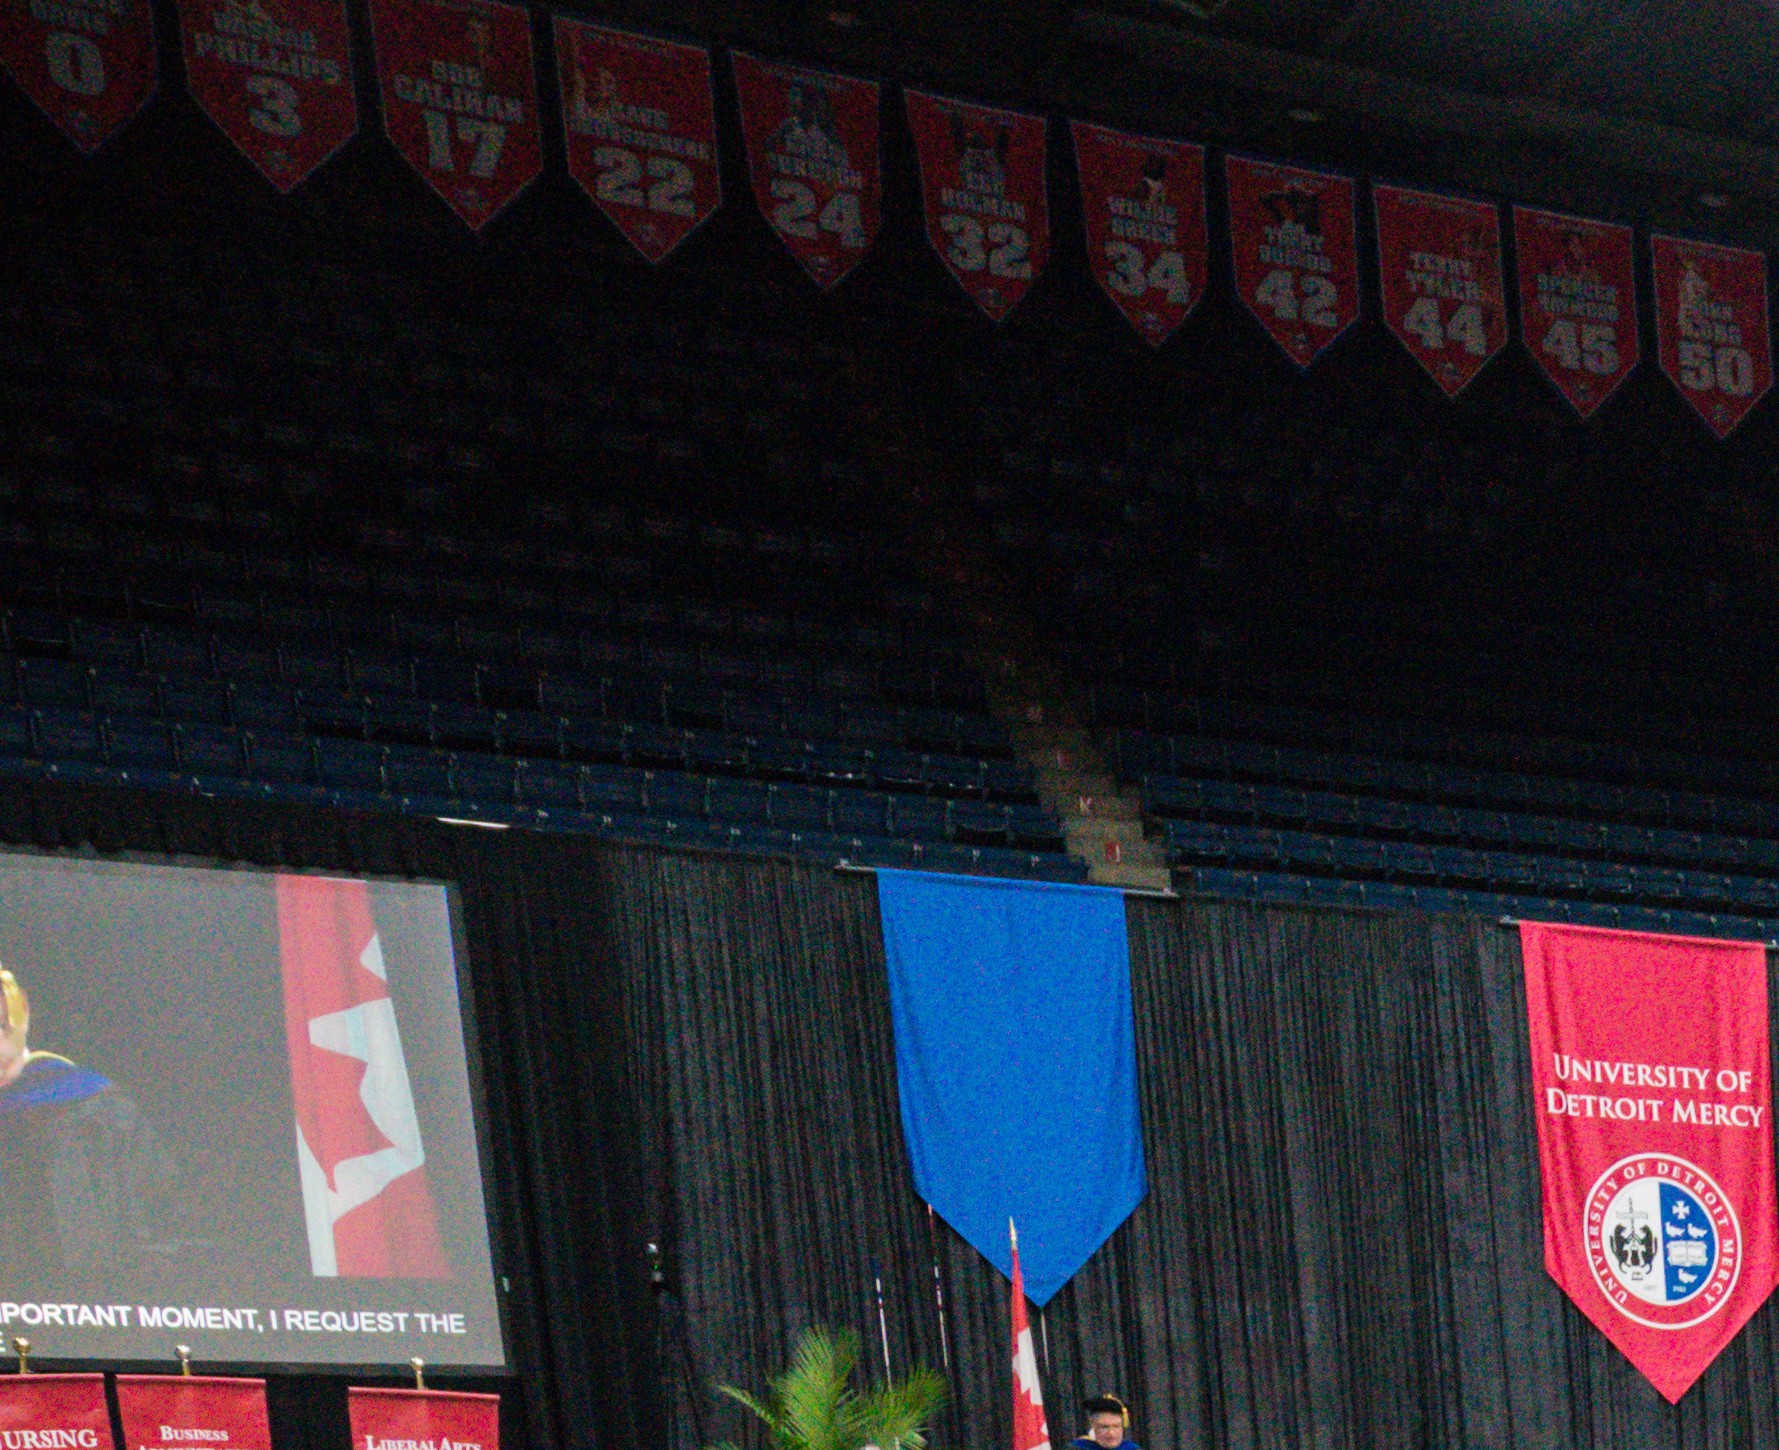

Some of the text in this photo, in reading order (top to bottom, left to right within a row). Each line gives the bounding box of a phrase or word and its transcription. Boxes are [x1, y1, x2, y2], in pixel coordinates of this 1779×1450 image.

[45, 31, 107, 95] 0
[194, 32, 342, 84] PHILLIPS
[245, 75, 302, 137] 3
[422, 108, 506, 178] 17
[593, 147, 696, 218] 22
[771, 178, 867, 248] 24
[939, 213, 1032, 280] 32
[1104, 240, 1190, 304] 34
[1255, 270, 1337, 328] 42
[1403, 297, 1487, 355] 44
[1542, 298, 1619, 375] 45
[1677, 340, 1753, 397] 50
[1553, 1052, 1752, 1093] UNIVERSITY OF
[1546, 1087, 1764, 1129] DETROIT MERCY
[1588, 1162, 1735, 1307] UNIVERSITY OF DETROIT MERCY
[0, 1303, 467, 1334] PORTANT MOMENT, I REQUEST THE
[0, 1429, 98, 1450] URSING
[160, 1425, 229, 1442] BUSINESS
